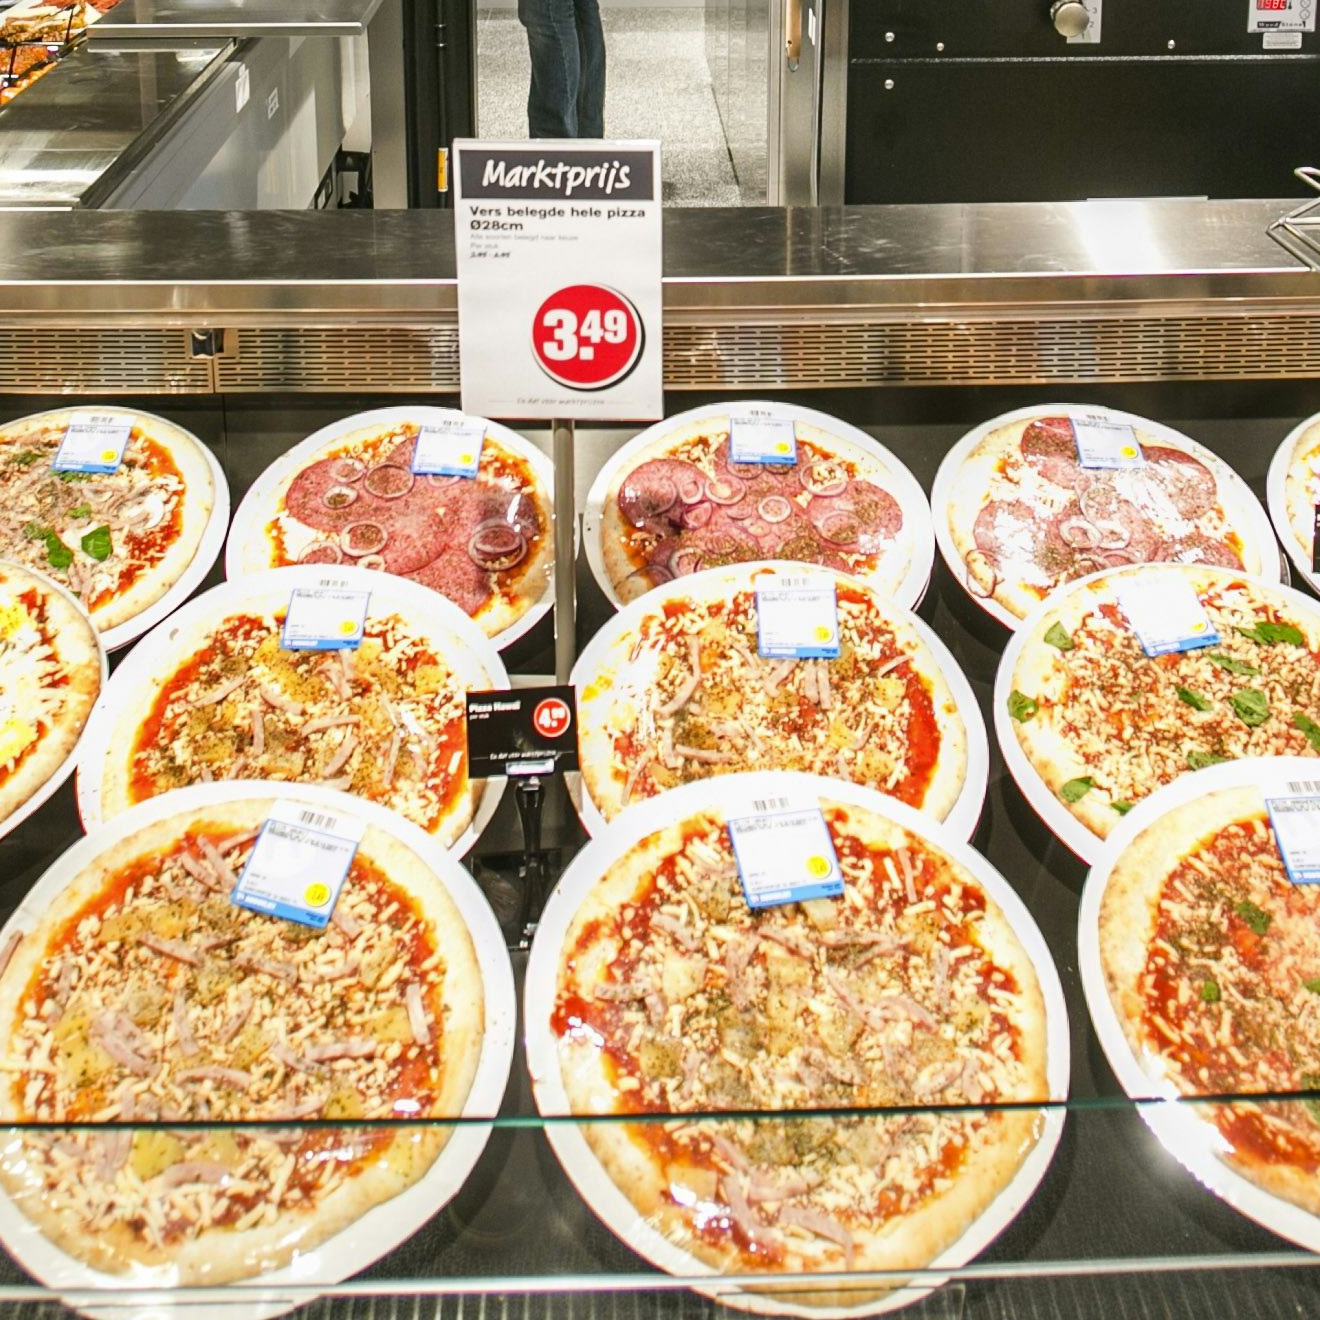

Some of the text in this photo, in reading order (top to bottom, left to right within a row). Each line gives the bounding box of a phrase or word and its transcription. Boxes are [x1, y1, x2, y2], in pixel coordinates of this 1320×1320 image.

[482, 159, 631, 196] Marktprijs
[469, 206, 646, 220] Vers belegde hele pizza
[469, 219, 524, 231] Ø28cm
[543, 308, 628, 361] 3.49
[468, 702, 493, 713] Pizza
